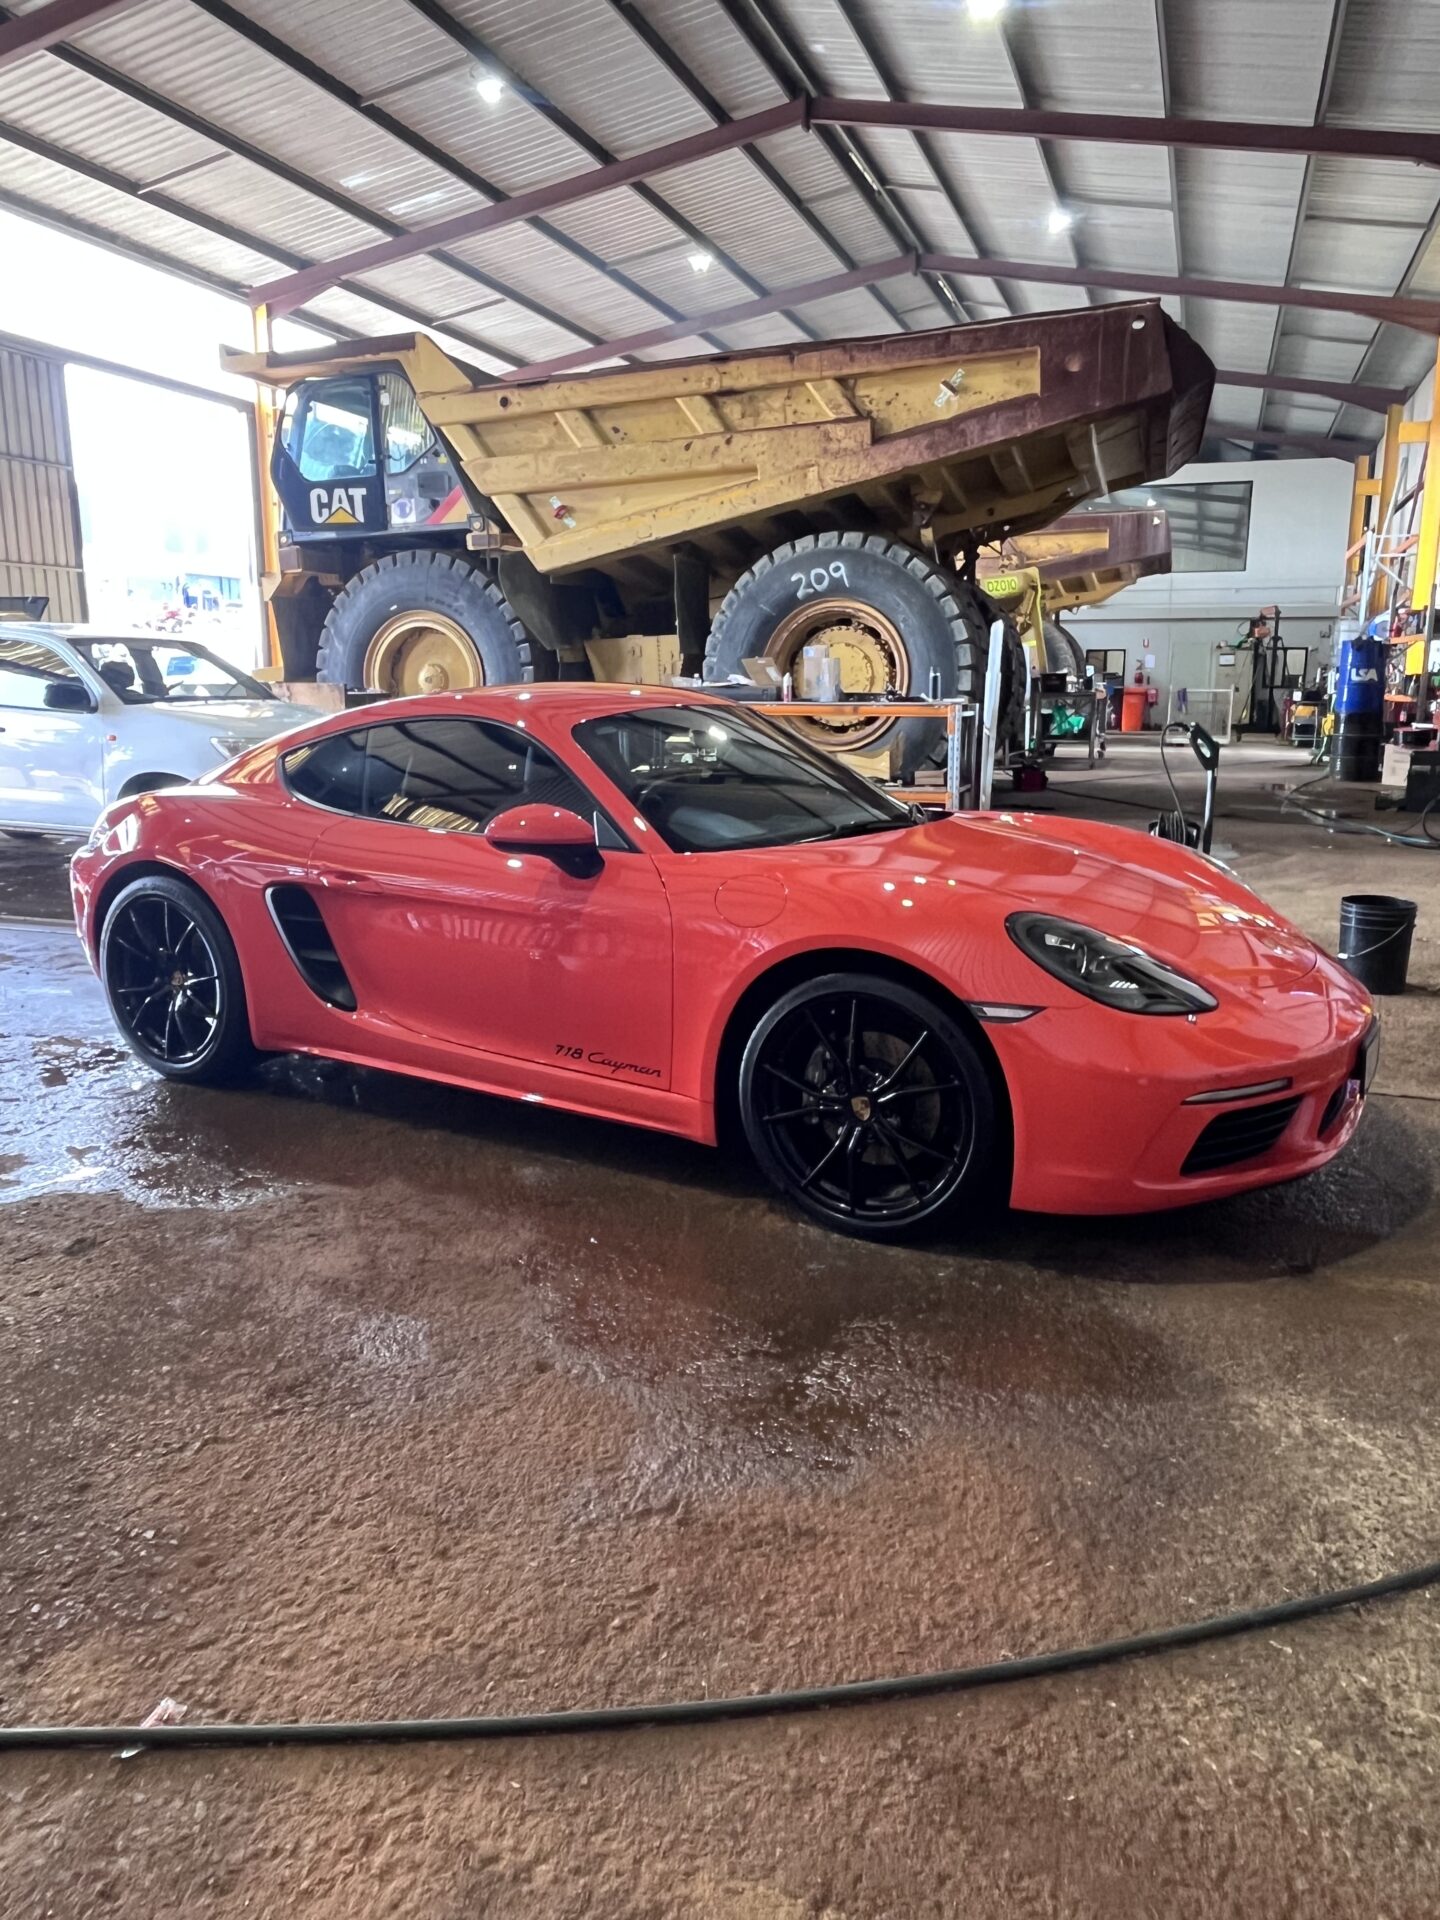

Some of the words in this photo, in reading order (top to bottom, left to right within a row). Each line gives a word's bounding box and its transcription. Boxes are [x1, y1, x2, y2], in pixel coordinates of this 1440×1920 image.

[309, 487, 367, 524] CAT
[790, 561, 849, 600] 209
[555, 1044, 584, 1060] 718
[587, 1052, 662, 1078] Cayman
